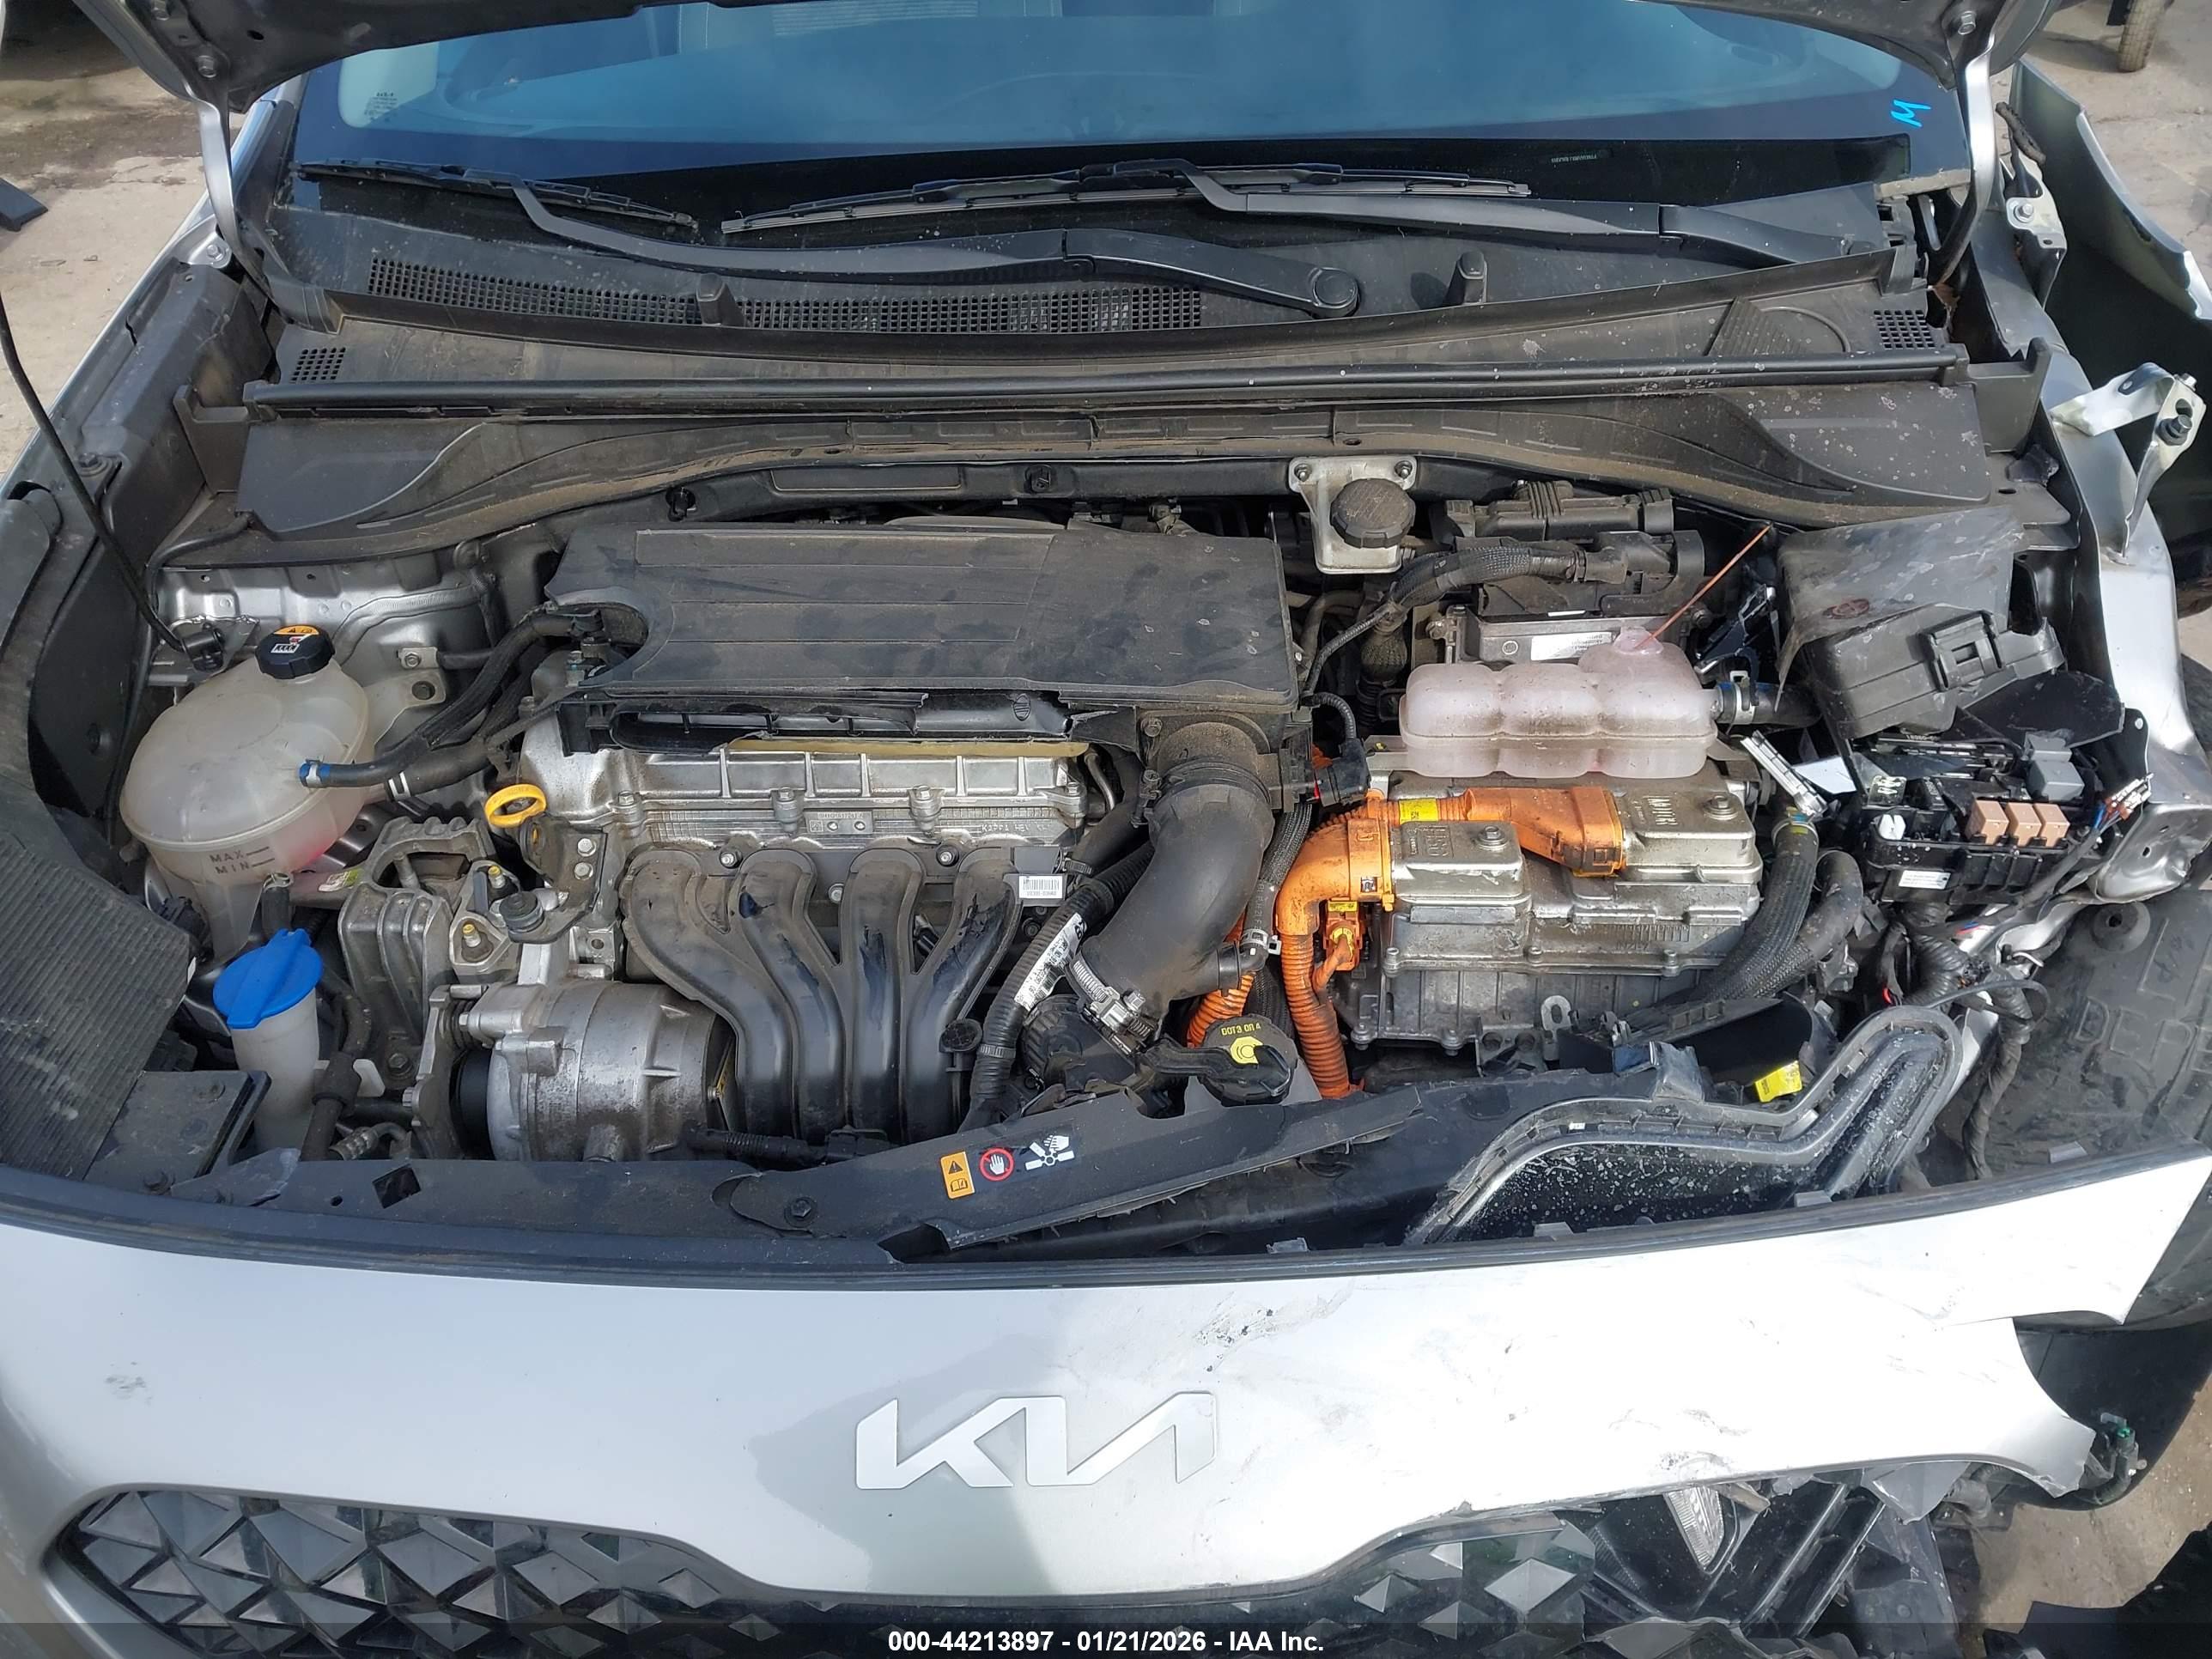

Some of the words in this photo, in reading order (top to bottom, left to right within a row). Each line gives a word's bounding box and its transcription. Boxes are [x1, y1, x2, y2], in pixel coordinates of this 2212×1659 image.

[210, 850, 244, 863] MAX
[215, 861, 250, 874] MIN
[857, 1390, 1217, 1490] KIA
